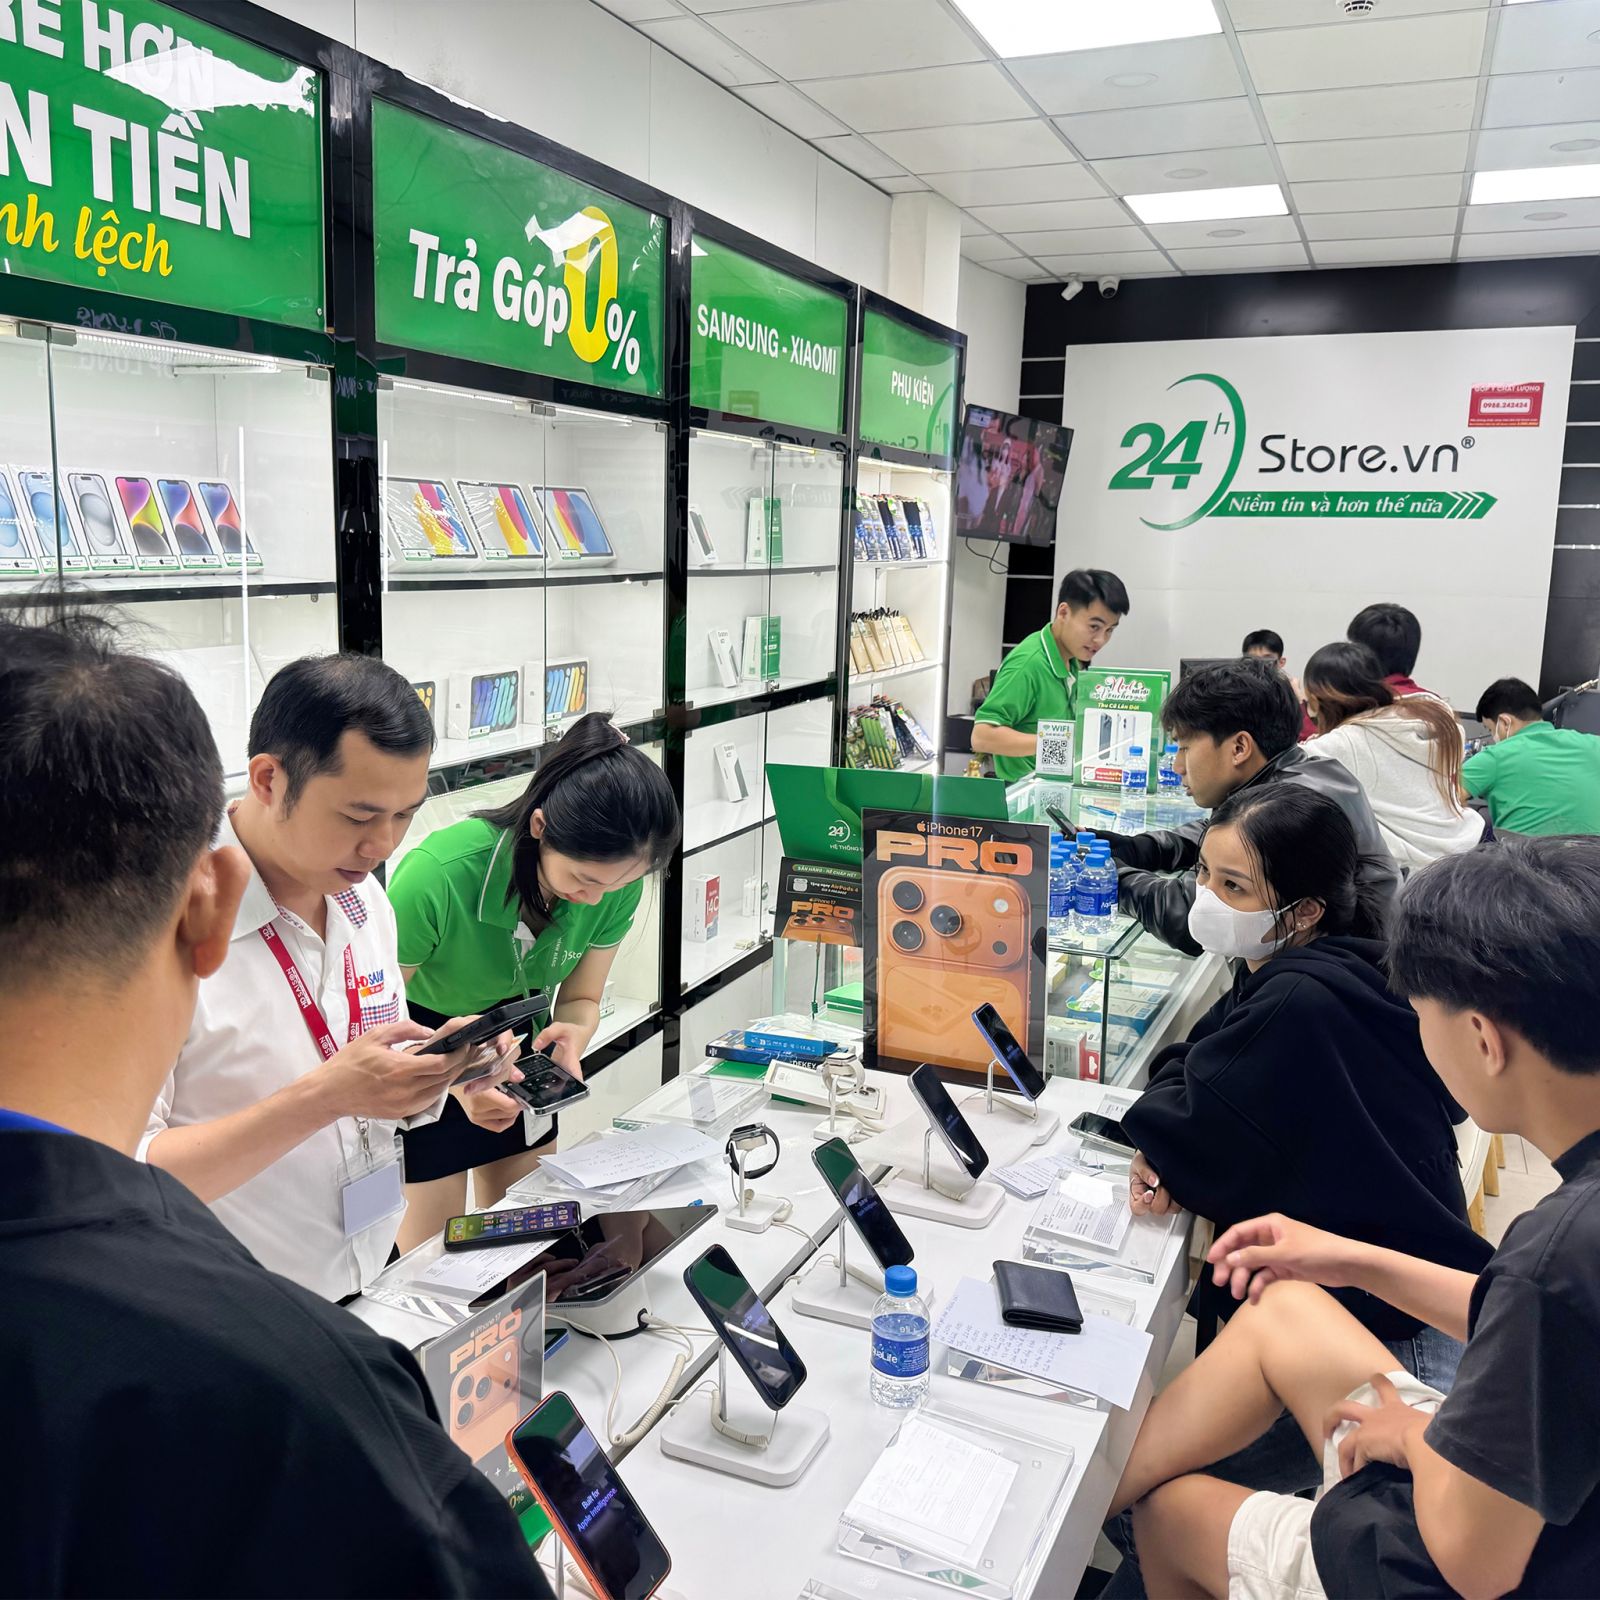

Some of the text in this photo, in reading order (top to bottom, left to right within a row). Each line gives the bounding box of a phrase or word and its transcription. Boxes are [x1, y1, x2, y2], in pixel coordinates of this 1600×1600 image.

[82, 0, 215, 113] HƠN
[73, 104, 250, 238] TIỀN
[74, 206, 173, 277] lệch
[409, 229, 477, 303] Trả
[493, 257, 568, 347] Góp
[697, 304, 778, 359] SAMSUNG
[790, 335, 837, 376] XIAOMI
[891, 371, 934, 410] PHỤ KIỆN
[1228, 493, 1444, 514] Niềm tin và hơn thế nữa
[1051, 724, 1070, 732] WIFI
[926, 822, 983, 837] iPhone 17
[876, 830, 1033, 876] PRO
[791, 900, 854, 919] PRO
[450, 1308, 522, 1374] PRO
[581, 1488, 600, 1510] Built for
[576, 1513, 593, 1532] Apple
